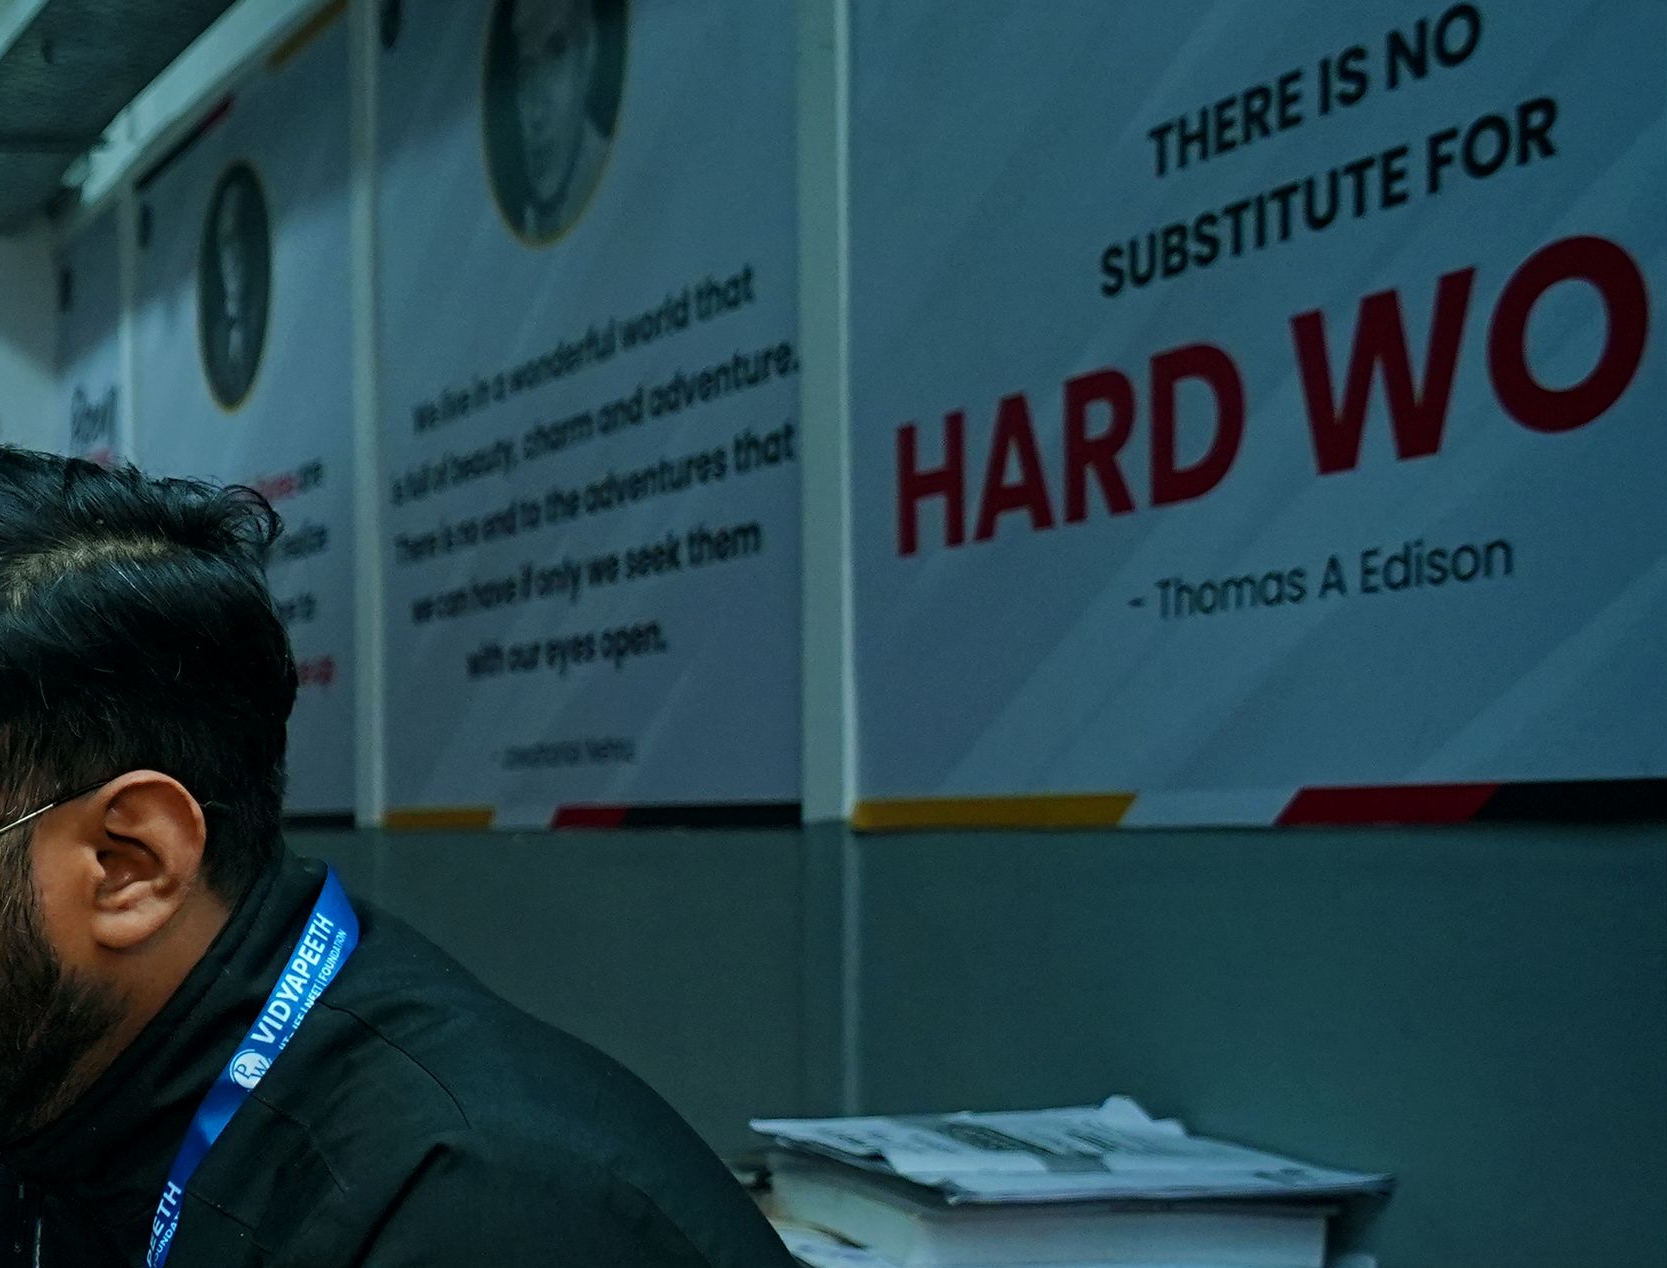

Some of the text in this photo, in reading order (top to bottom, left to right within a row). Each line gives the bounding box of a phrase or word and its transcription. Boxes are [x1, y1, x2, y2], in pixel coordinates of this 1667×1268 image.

[1149, 3, 1484, 178] THERE IS NO
[1099, 96, 1560, 299] SUBSTITUTE FOR
[509, 316, 616, 393] wonderful
[620, 287, 688, 348] world
[695, 264, 754, 321] that
[524, 411, 594, 461] charm
[598, 385, 643, 435] and
[896, 234, 1651, 558] HARD WO
[482, 500, 516, 541] end
[520, 497, 540, 530] to
[546, 487, 580, 524] the
[585, 448, 727, 514] adventures
[734, 421, 795, 473] that
[521, 562, 533, 598] if
[538, 559, 580, 605] only
[587, 553, 619, 585] we
[627, 531, 680, 580] seek
[687, 522, 762, 568] them
[1158, 564, 1307, 622] Thomas
[1318, 554, 1347, 599] A
[1361, 536, 1514, 593] Edison
[508, 643, 539, 672] our
[546, 634, 595, 679] eyes
[250, 912, 335, 1045] VIDYAPEETH
[317, 928, 348, 981] FOUNDATION
